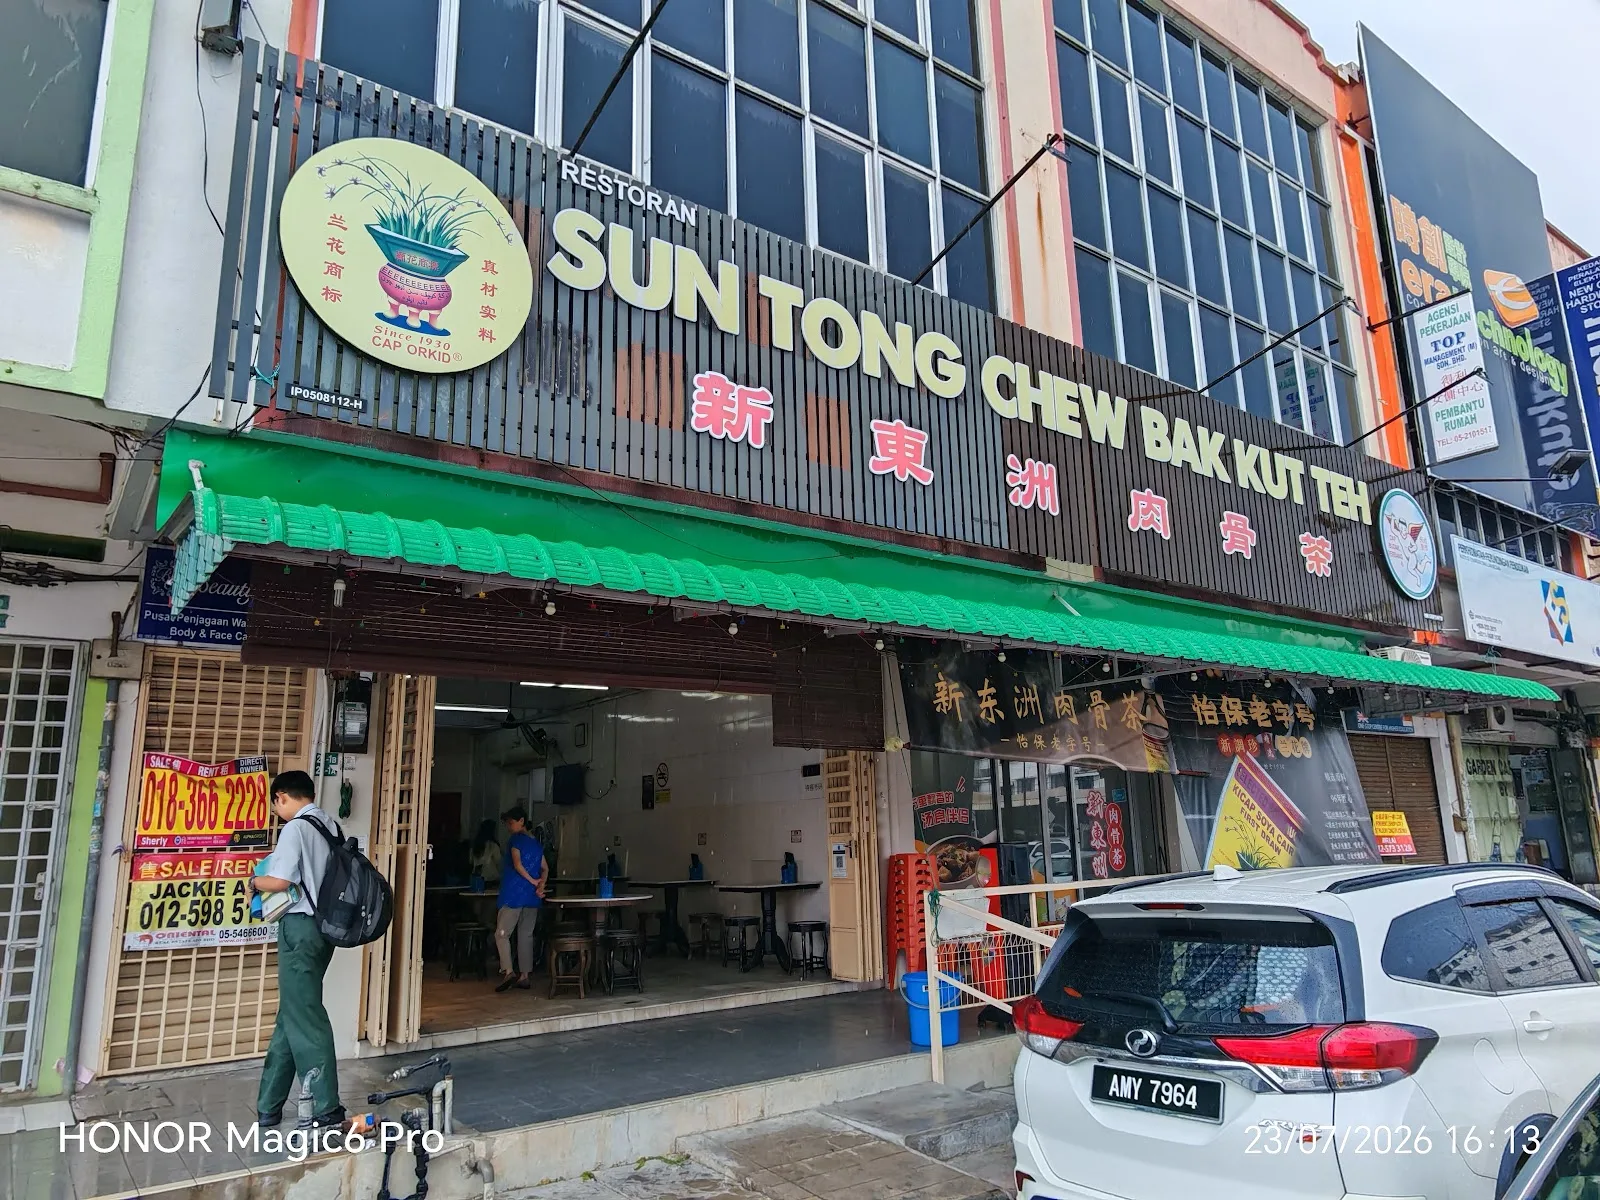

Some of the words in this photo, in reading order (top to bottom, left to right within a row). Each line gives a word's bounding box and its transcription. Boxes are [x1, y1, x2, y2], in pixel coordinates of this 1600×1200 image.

[561, 159, 697, 227] RESTORAN
[321, 213, 348, 303] 兰花商标
[478, 259, 498, 344] 真材实料
[1569, 283, 1593, 299] NEW
[1427, 302, 1459, 324] AGENSI
[1420, 312, 1472, 338] PEKERJAAN
[372, 335, 402, 351] CAP
[374, 325, 412, 341] Since
[419, 336, 451, 351] 1930
[1430, 331, 1466, 353] TOP
[1424, 345, 1467, 367] MANAGEMENT
[1476, 309, 1568, 397] chnology
[547, 208, 740, 335] SUN
[759, 275, 967, 399] TONG
[981, 355, 1128, 450] CHEW
[1141, 405, 1231, 484] BAK
[1233, 439, 1305, 505] KUT
[1310, 465, 1372, 526] TEH
[290, 386, 363, 410] IP0508112-H
[1435, 398, 1485, 422] PEMBANTU
[1444, 413, 1477, 432] RUMAH
[177, 614, 229, 627] Penjagaan
[232, 618, 247, 628] Wa
[170, 627, 197, 639] Body
[199, 629, 207, 638] &
[209, 630, 233, 640] Face
[235, 632, 248, 641] Ca
[1192, 693, 1315, 730] 怡保老字号
[150, 755, 171, 768] SALE
[198, 766, 219, 777] RENT
[240, 757, 263, 767] DIRECT
[240, 765, 263, 773] OWNER
[316, 753, 337, 764] 2-1B
[142, 771, 219, 831] 018-366
[223, 773, 267, 829] 2228
[1232, 783, 1256, 812] KICAP
[1255, 810, 1275, 838] SOYA
[1277, 834, 1295, 856] CAIR
[1240, 806, 1260, 832] FIRST
[1261, 830, 1281, 855] DRAW
[141, 836, 168, 848] Sherly
[149, 880, 226, 899] JACKIE
[232, 880, 246, 896] A
[140, 898, 224, 930] 012-598
[155, 929, 216, 939] ORIENTAL
[219, 926, 268, 939] 05-5466600
[1108, 1073, 1142, 1101] AMY
[1149, 1079, 1198, 1109] 7964
